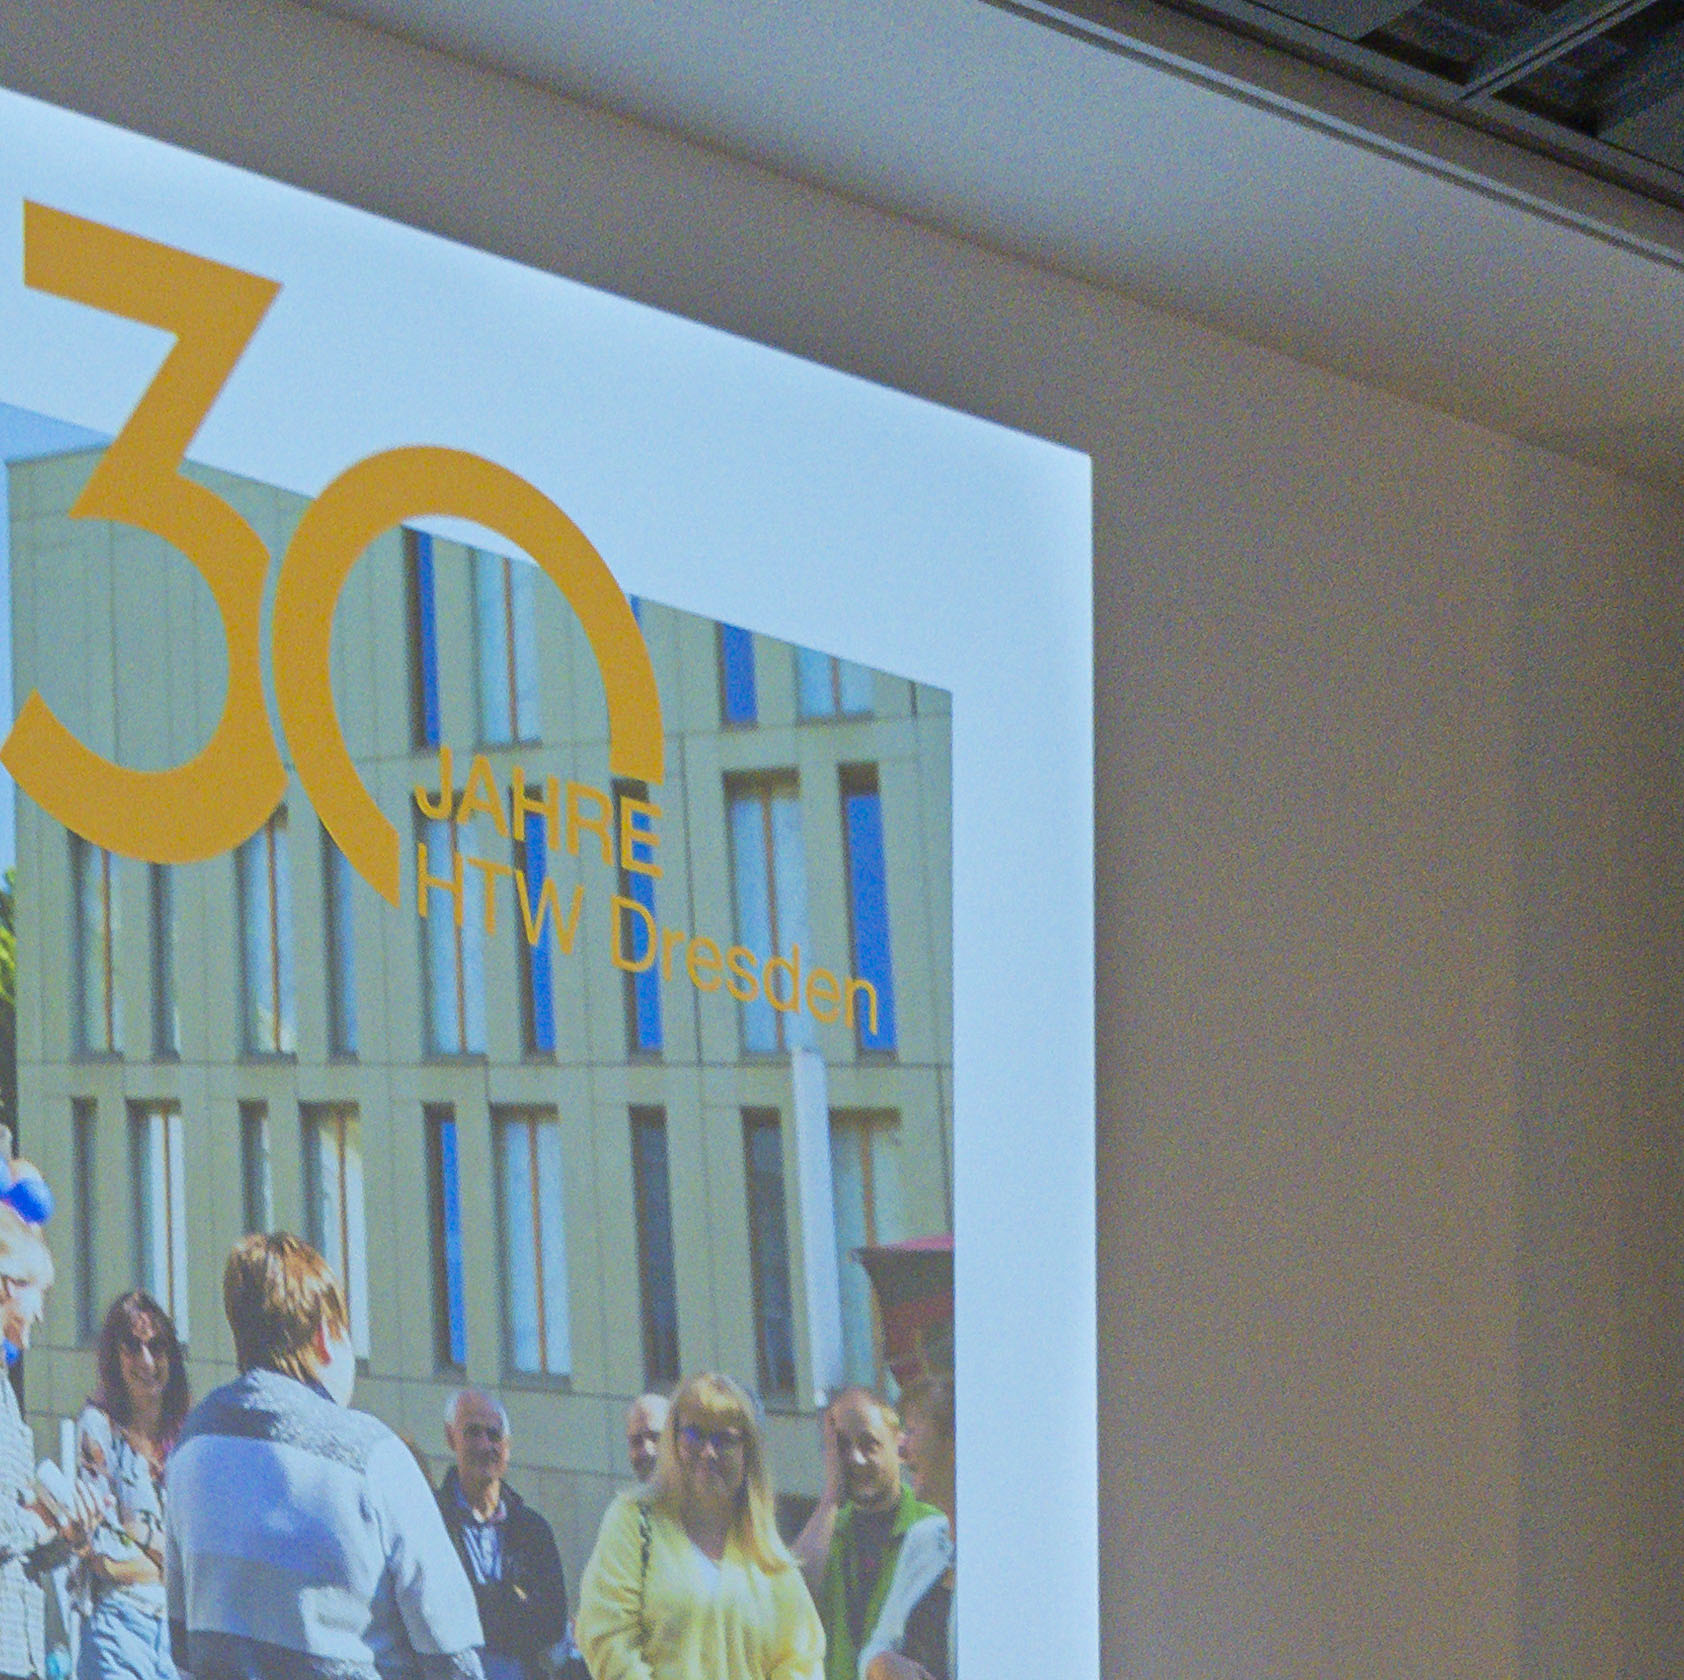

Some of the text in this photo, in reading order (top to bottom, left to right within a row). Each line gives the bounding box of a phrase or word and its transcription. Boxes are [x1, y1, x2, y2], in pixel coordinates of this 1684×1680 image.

[414, 746, 664, 880] JAHRE
[417, 842, 879, 1037] HTW Dresden
